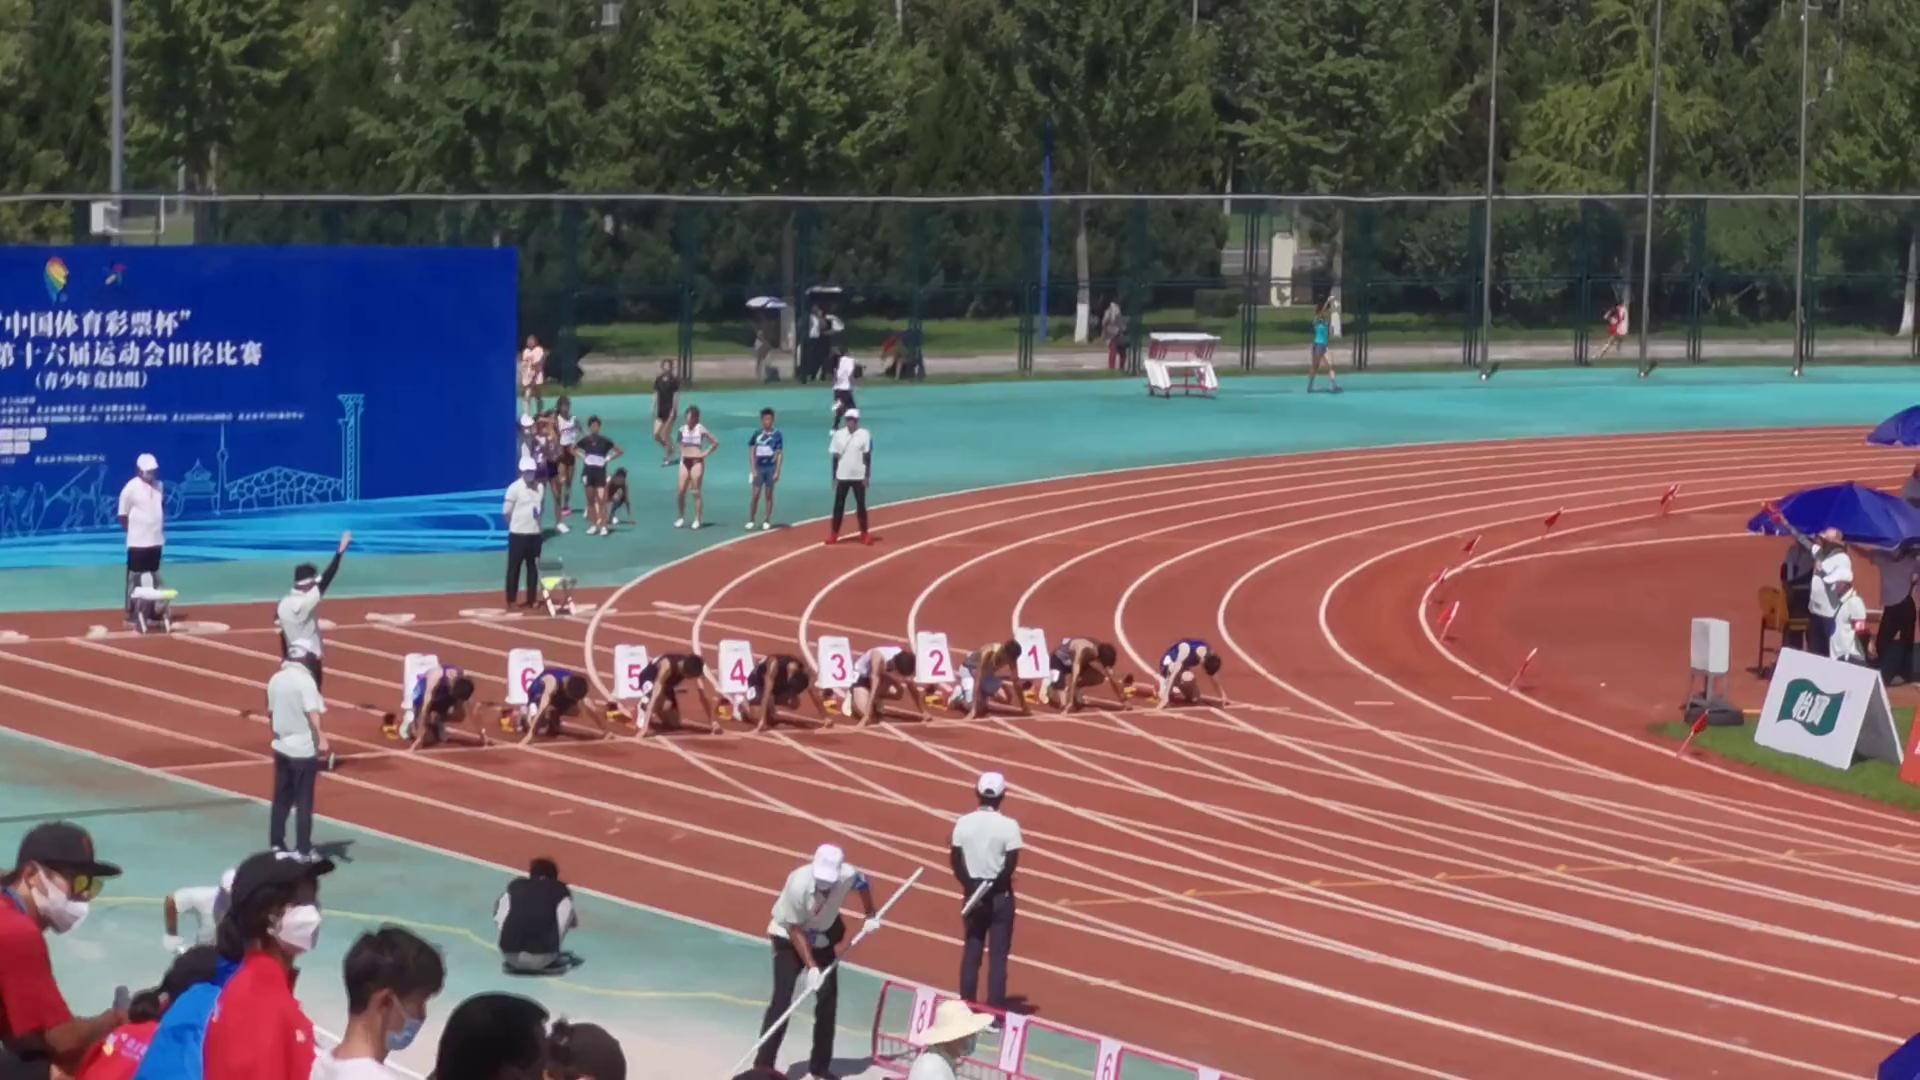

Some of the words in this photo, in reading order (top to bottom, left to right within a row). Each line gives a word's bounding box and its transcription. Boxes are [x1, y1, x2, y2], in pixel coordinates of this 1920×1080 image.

[830, 653, 847, 681] 3
[929, 649, 947, 676] 2
[1027, 644, 1040, 671] 1
[521, 667, 537, 695] 6
[627, 664, 642, 692] 5
[730, 658, 748, 686] 4
[917, 1000, 928, 1034] 8
[1008, 1026, 1019, 1061] 7
[1102, 1053, 1113, 1080] 6
